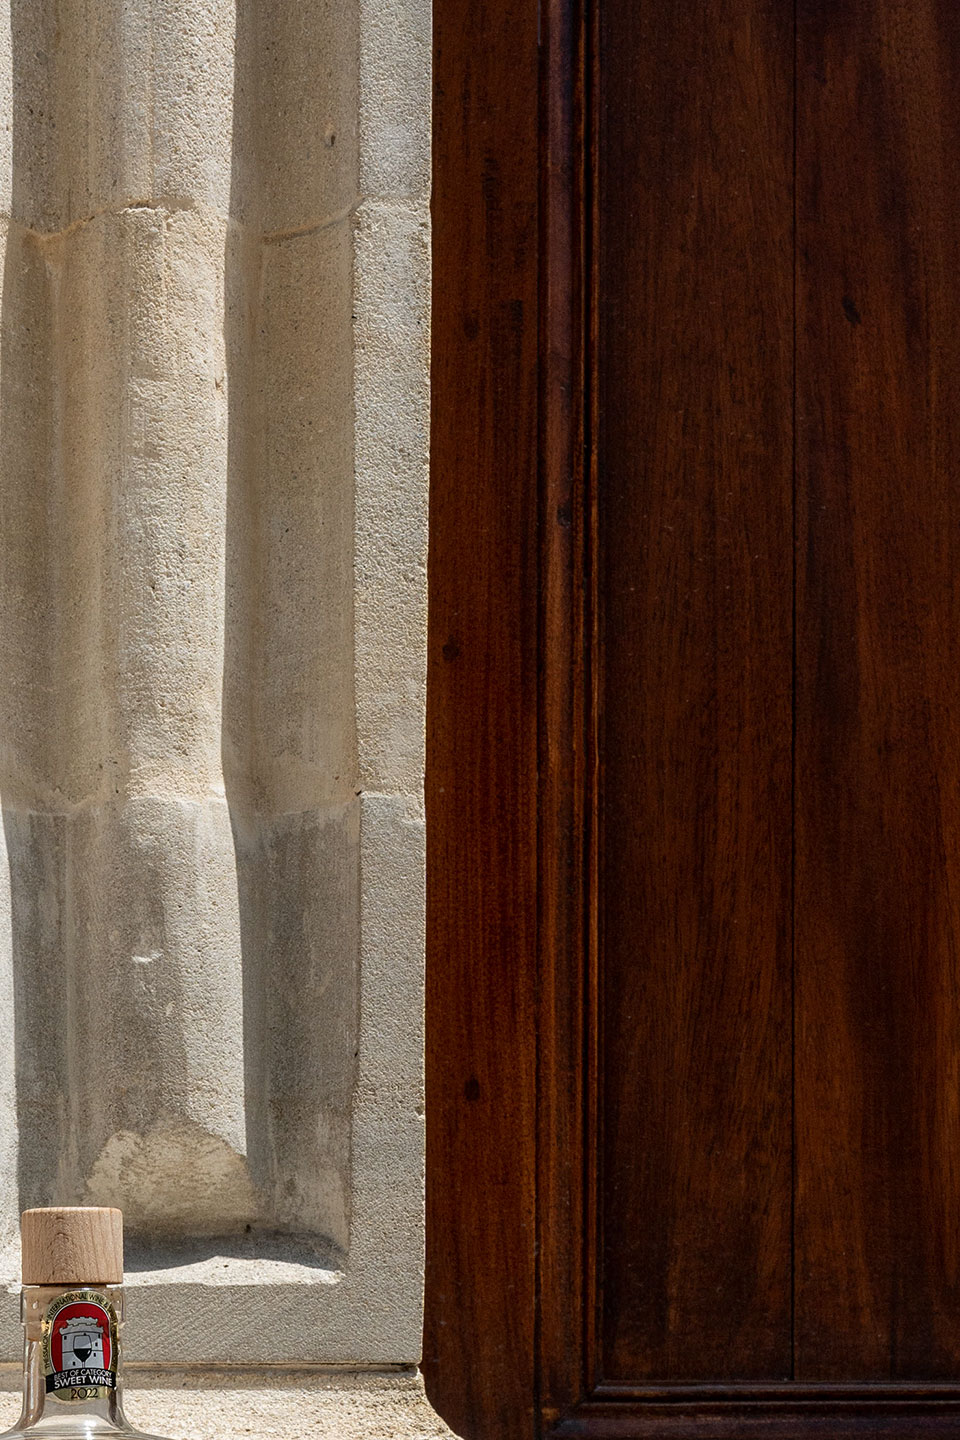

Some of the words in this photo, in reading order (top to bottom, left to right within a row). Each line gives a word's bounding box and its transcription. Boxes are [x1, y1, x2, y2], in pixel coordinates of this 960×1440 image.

[54, 1371, 68, 1380] BEST
[80, 1368, 112, 1378] CATEGORY
[54, 1376, 86, 1389] SWEET
[88, 1376, 112, 1387] WINE
[70, 1387, 98, 1399] 2022
